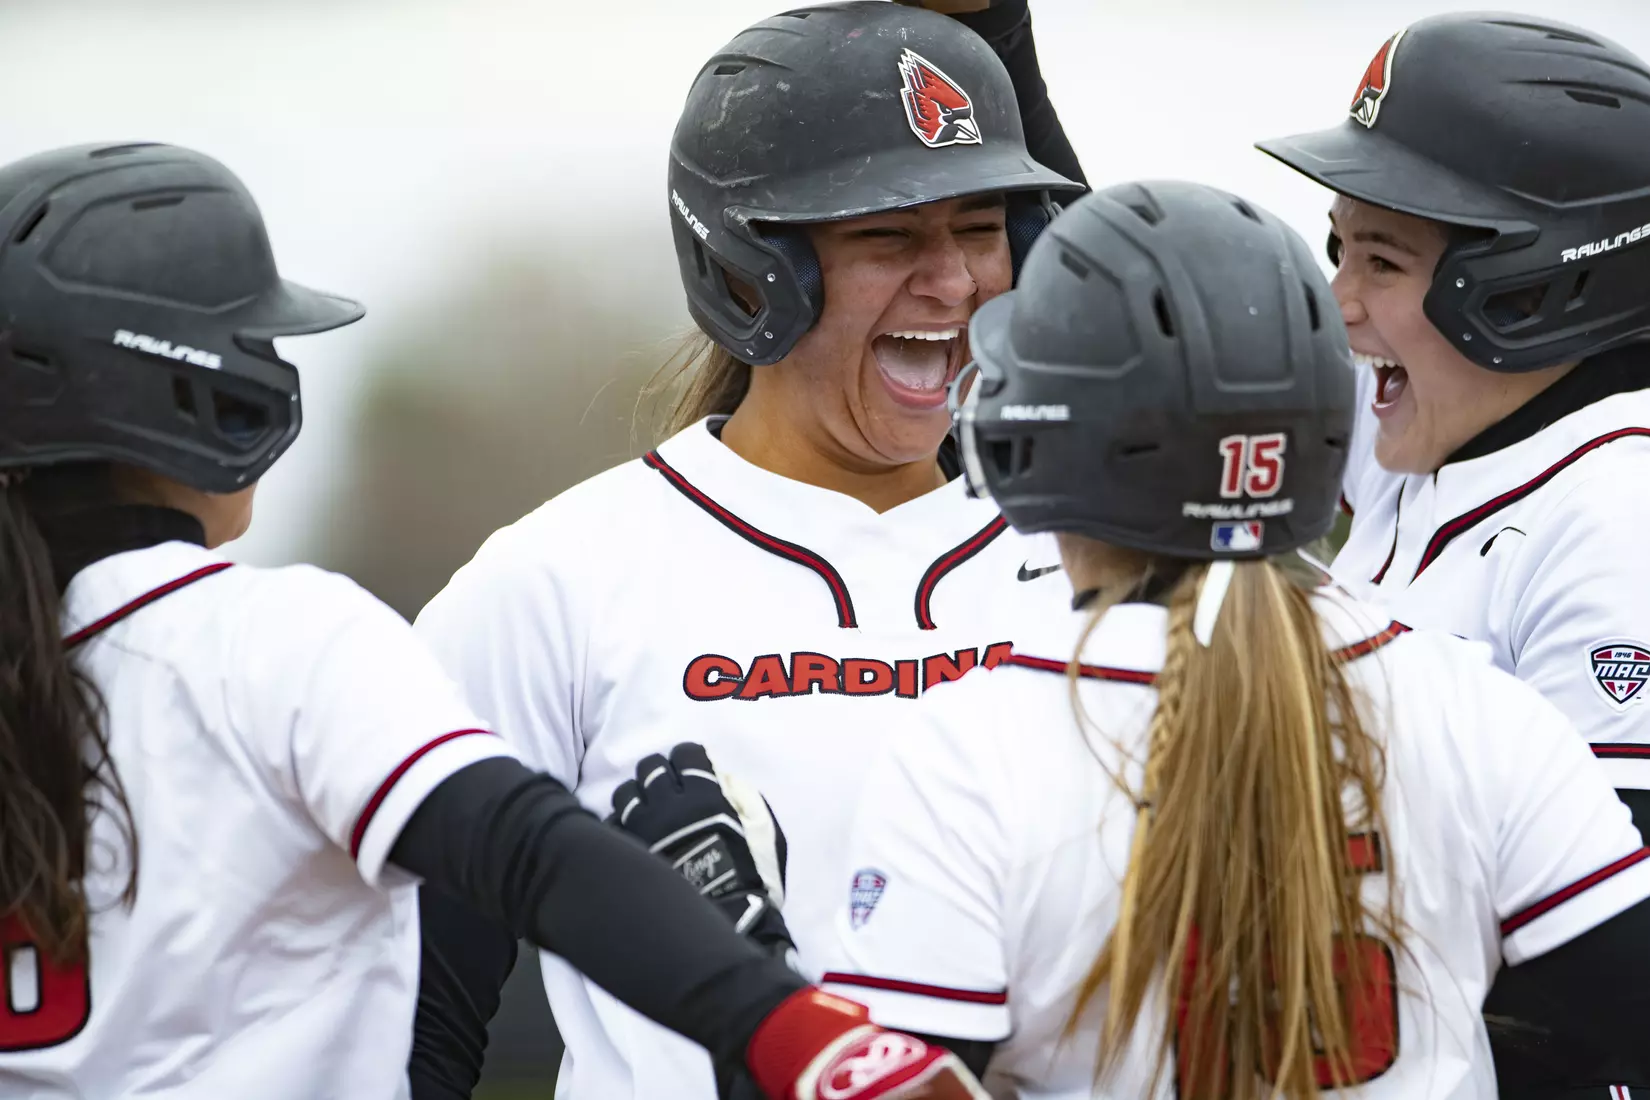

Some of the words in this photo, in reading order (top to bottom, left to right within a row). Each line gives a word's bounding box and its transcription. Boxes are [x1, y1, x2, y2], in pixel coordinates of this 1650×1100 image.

[1561, 223, 1650, 263] RAWLINGS
[1219, 433, 1286, 498] 15
[1594, 663, 1650, 678] MAC
